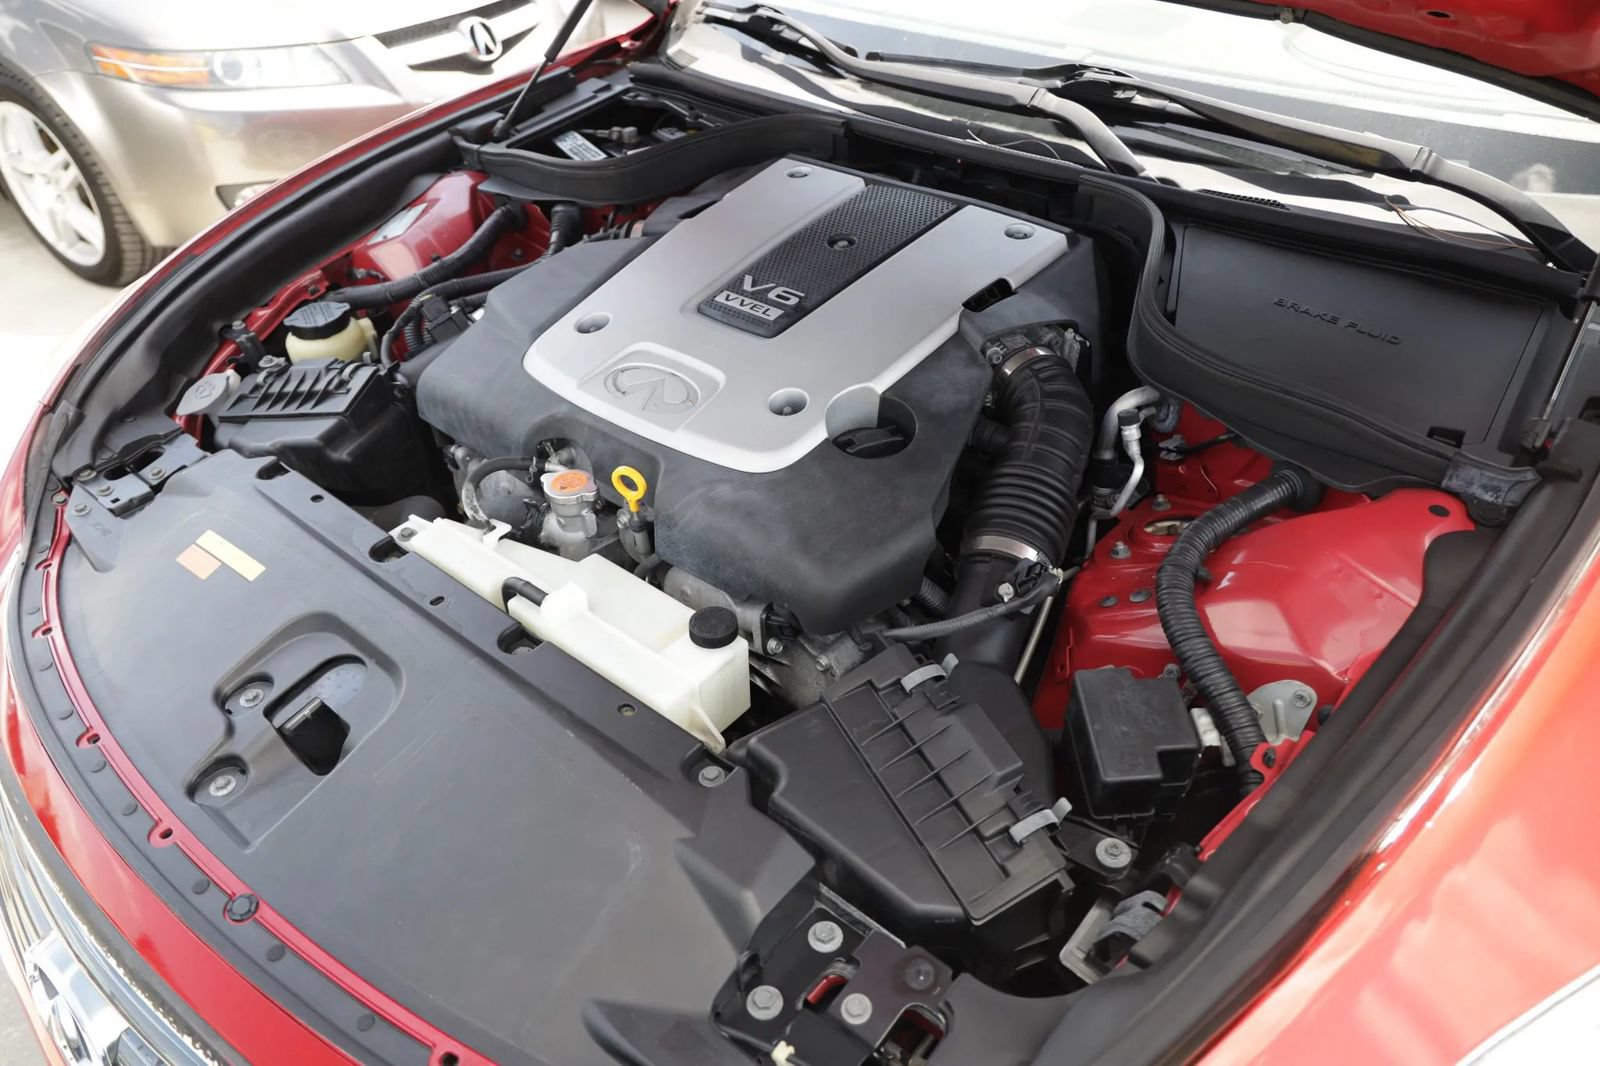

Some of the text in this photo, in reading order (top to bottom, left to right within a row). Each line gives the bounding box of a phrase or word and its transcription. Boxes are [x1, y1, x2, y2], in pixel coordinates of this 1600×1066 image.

[724, 293, 772, 317] VVEL
[743, 274, 805, 305] V6
[1273, 297, 1401, 346] BRAKE FLUID
